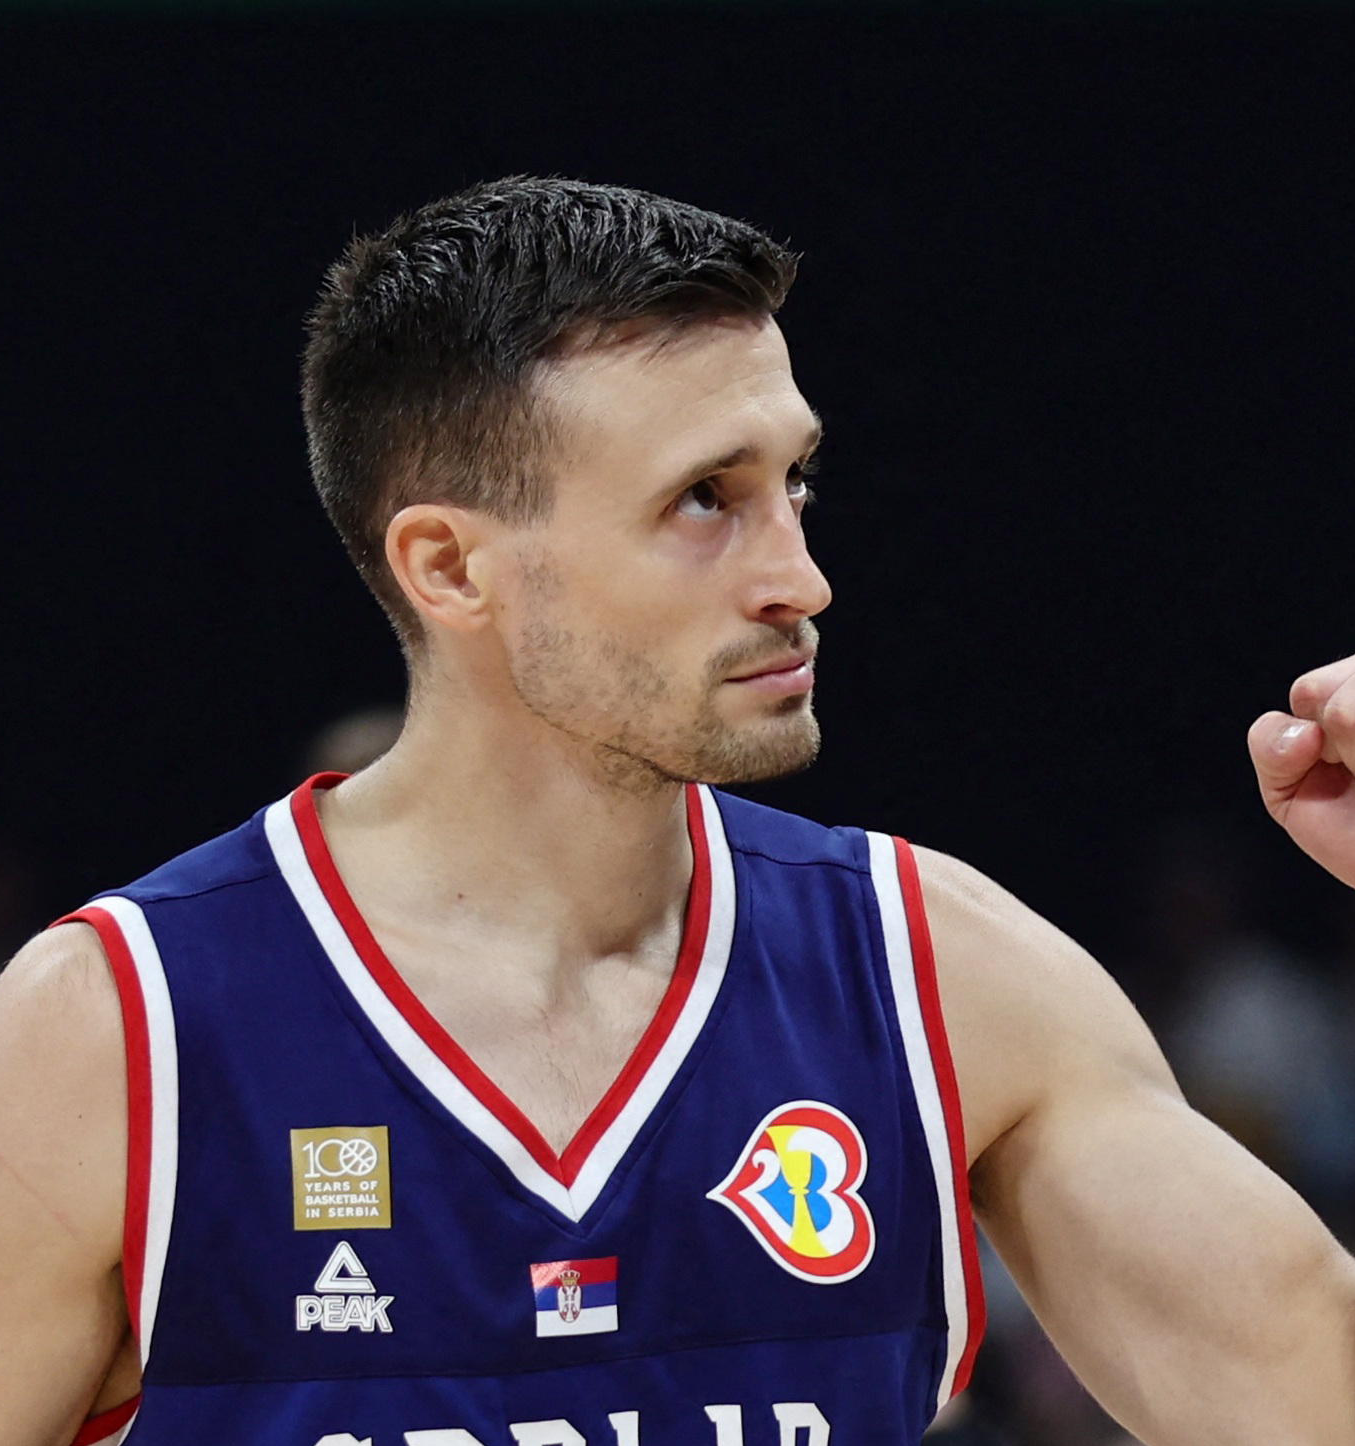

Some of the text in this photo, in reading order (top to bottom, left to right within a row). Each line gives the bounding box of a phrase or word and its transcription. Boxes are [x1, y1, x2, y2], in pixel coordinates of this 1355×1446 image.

[304, 1180, 379, 1193] YEARS OF
[305, 1193, 380, 1206] BASKETBALL
[305, 1206, 380, 1219] IN SERBIA
[295, 1294, 395, 1333] PEAK
